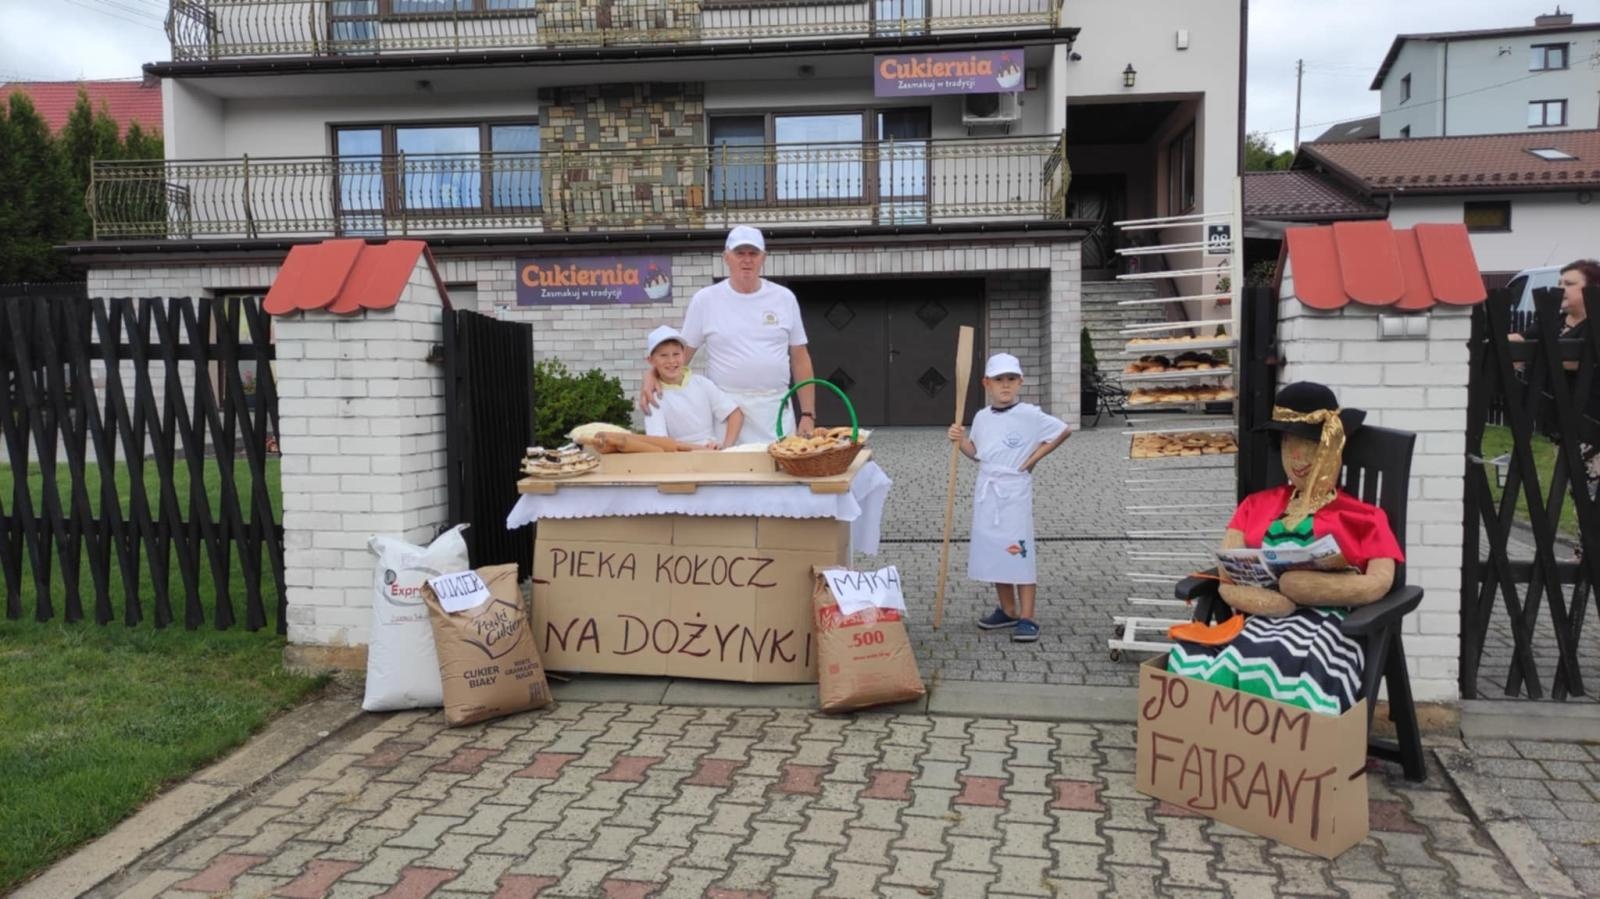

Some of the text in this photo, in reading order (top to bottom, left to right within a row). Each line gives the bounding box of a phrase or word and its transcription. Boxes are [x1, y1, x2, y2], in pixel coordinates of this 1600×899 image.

[880, 55, 993, 80] Cukiernia
[945, 79, 976, 90] tradycji
[522, 263, 640, 288] Cukiernia
[541, 288, 580, 299] Zasmakuj
[590, 288, 622, 299] tradycji
[550, 547, 777, 588] PIEKA KOŁOCZ
[545, 617, 601, 654] NA
[612, 611, 812, 668] DOŻYNKI
[853, 630, 885, 648] 500
[463, 665, 500, 679] CUKIER
[1142, 674, 1312, 751] JO MOM
[1150, 731, 1337, 841] FAJRANT
